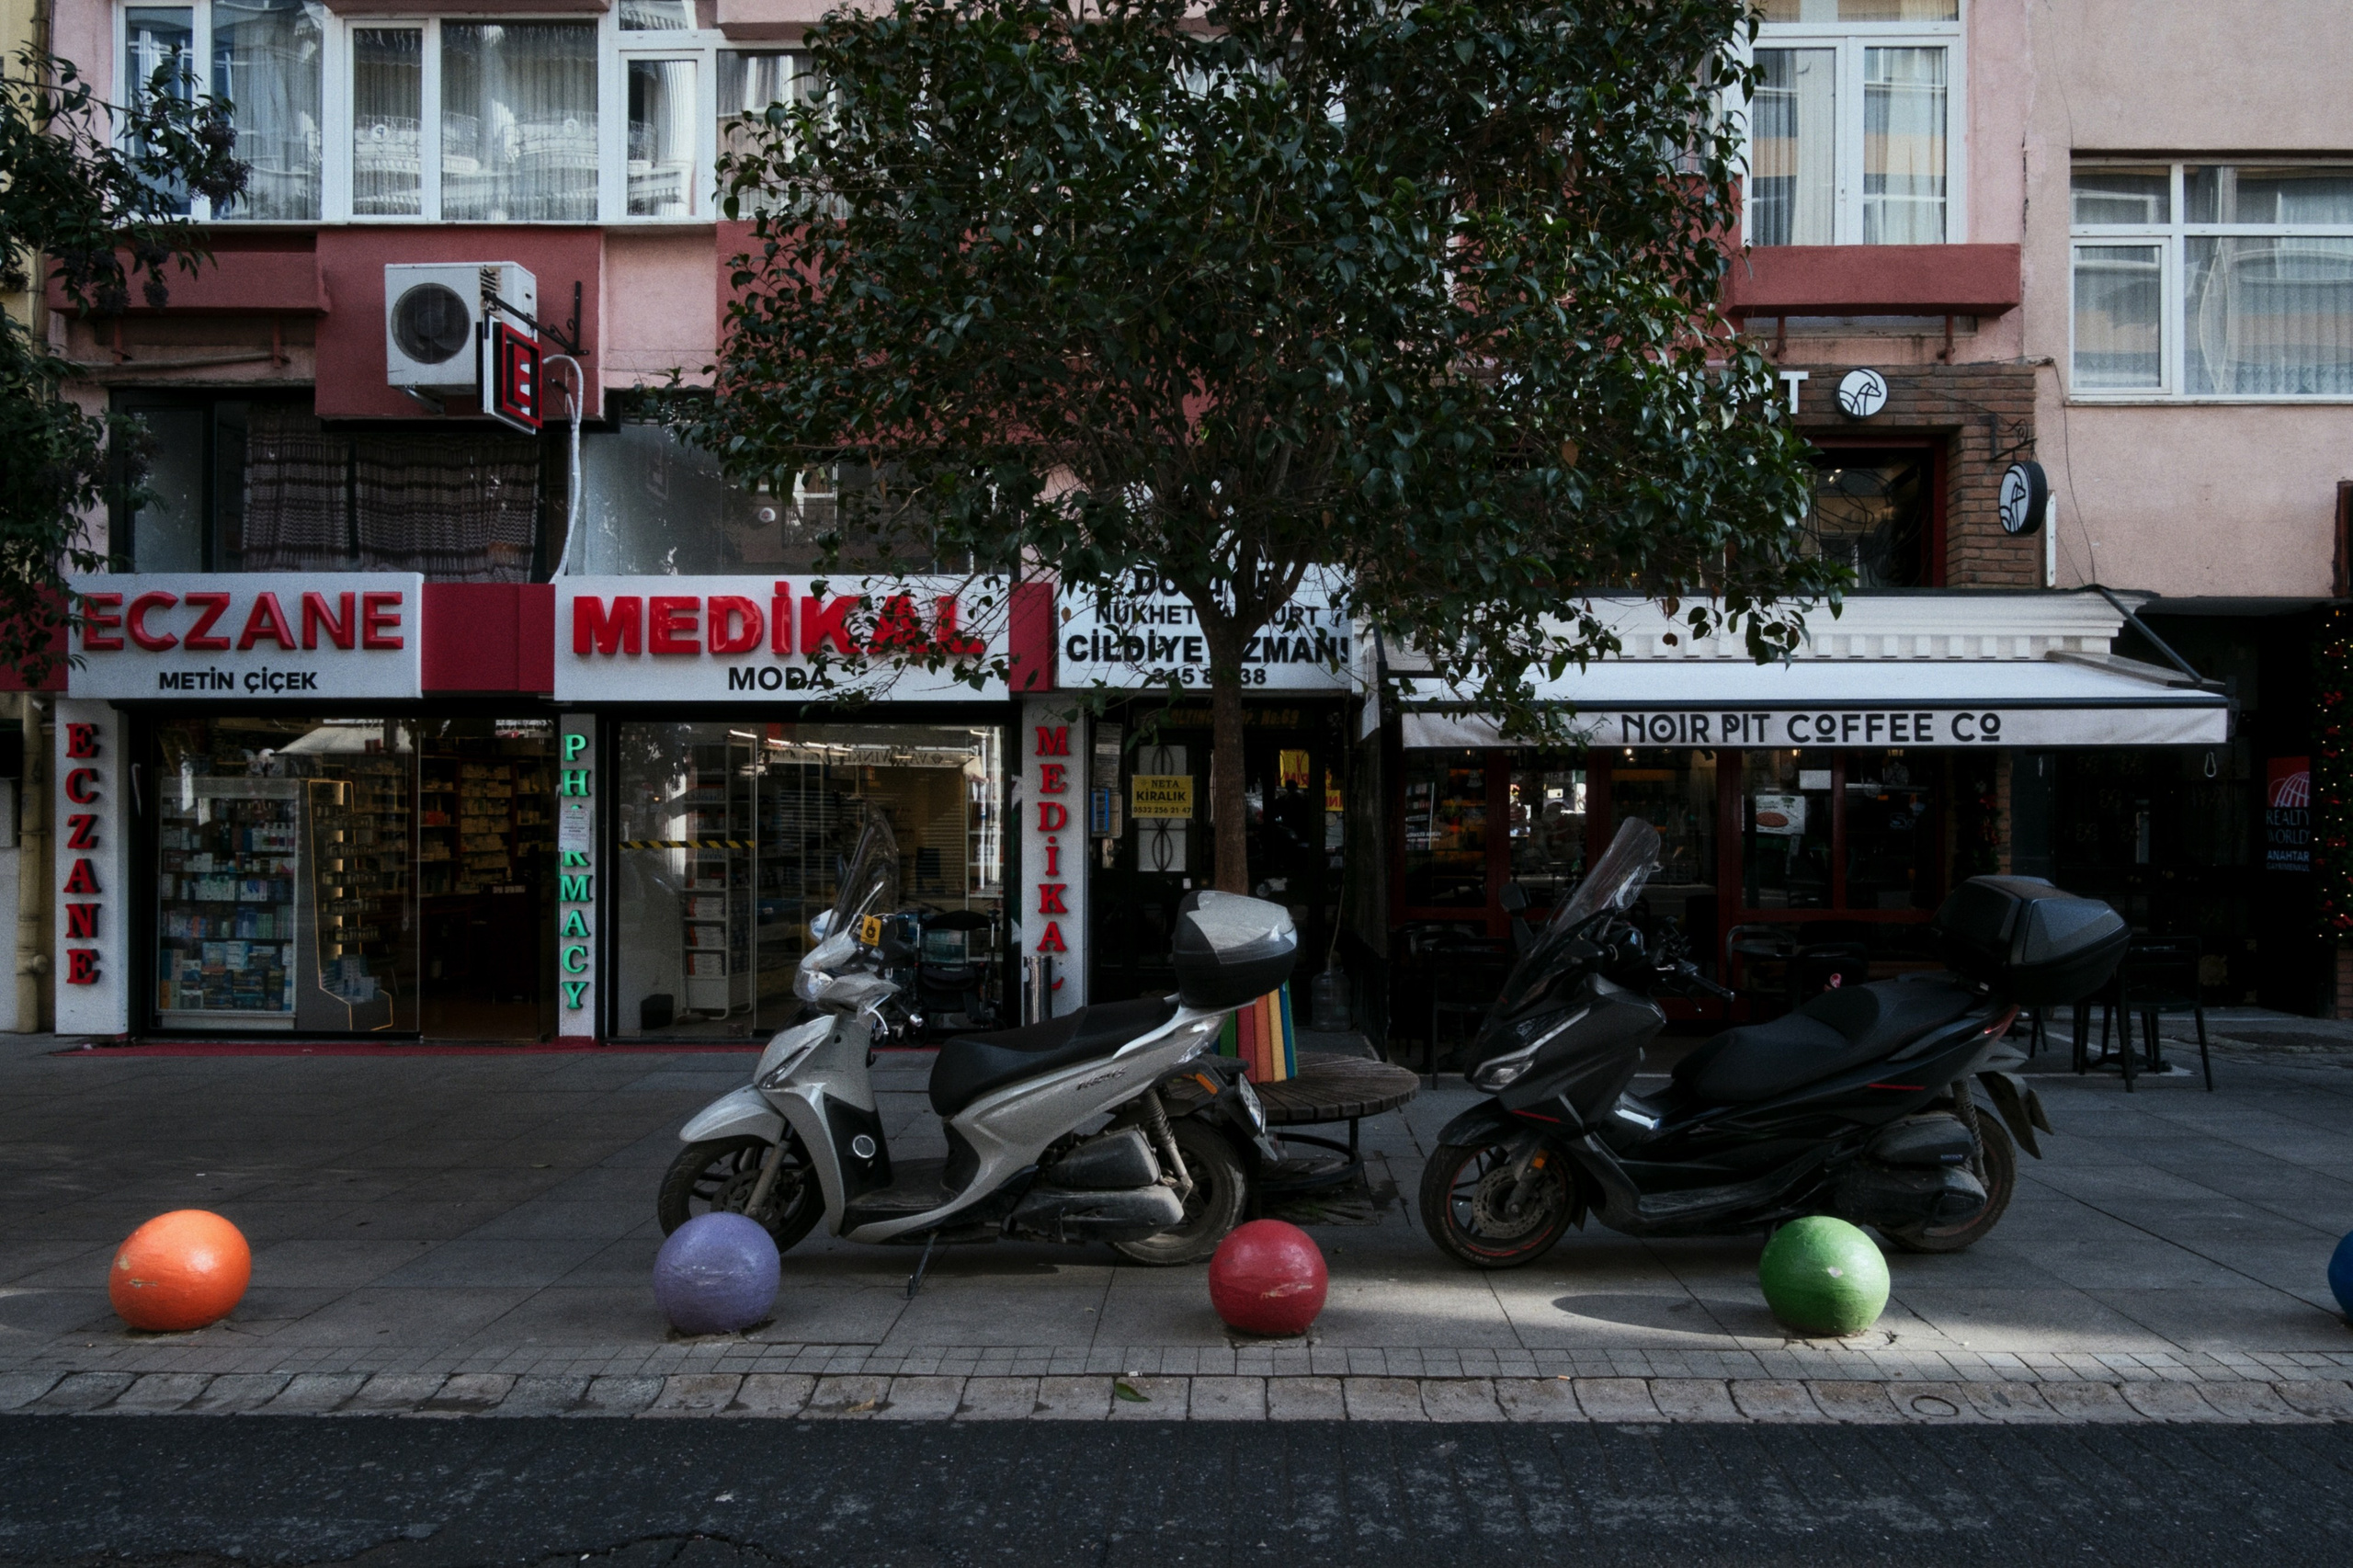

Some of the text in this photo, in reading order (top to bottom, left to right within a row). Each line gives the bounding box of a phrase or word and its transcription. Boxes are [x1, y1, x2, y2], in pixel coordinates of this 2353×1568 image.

[84, 591, 404, 652] ECZANE
[573, 581, 985, 655] MEDİKAL
[1096, 599, 1194, 624] NÜKHET
[1065, 629, 1348, 664] CİLDİYE ZMANI
[159, 666, 318, 694] METİN ÇİÇEK
[728, 666, 829, 690] MODA
[1621, 713, 1710, 743] NOIR
[1722, 713, 1770, 743] PIT
[1787, 713, 1933, 743] COFFEE
[1136, 788, 1186, 801] KİRALIK
[1152, 779, 1179, 788] NETA
[2266, 809, 2310, 825] REALTY
[63, 723, 101, 983] ECZANE
[1035, 726, 1070, 990] MEDİKA
[2267, 849, 2310, 862] ANAHTAR
